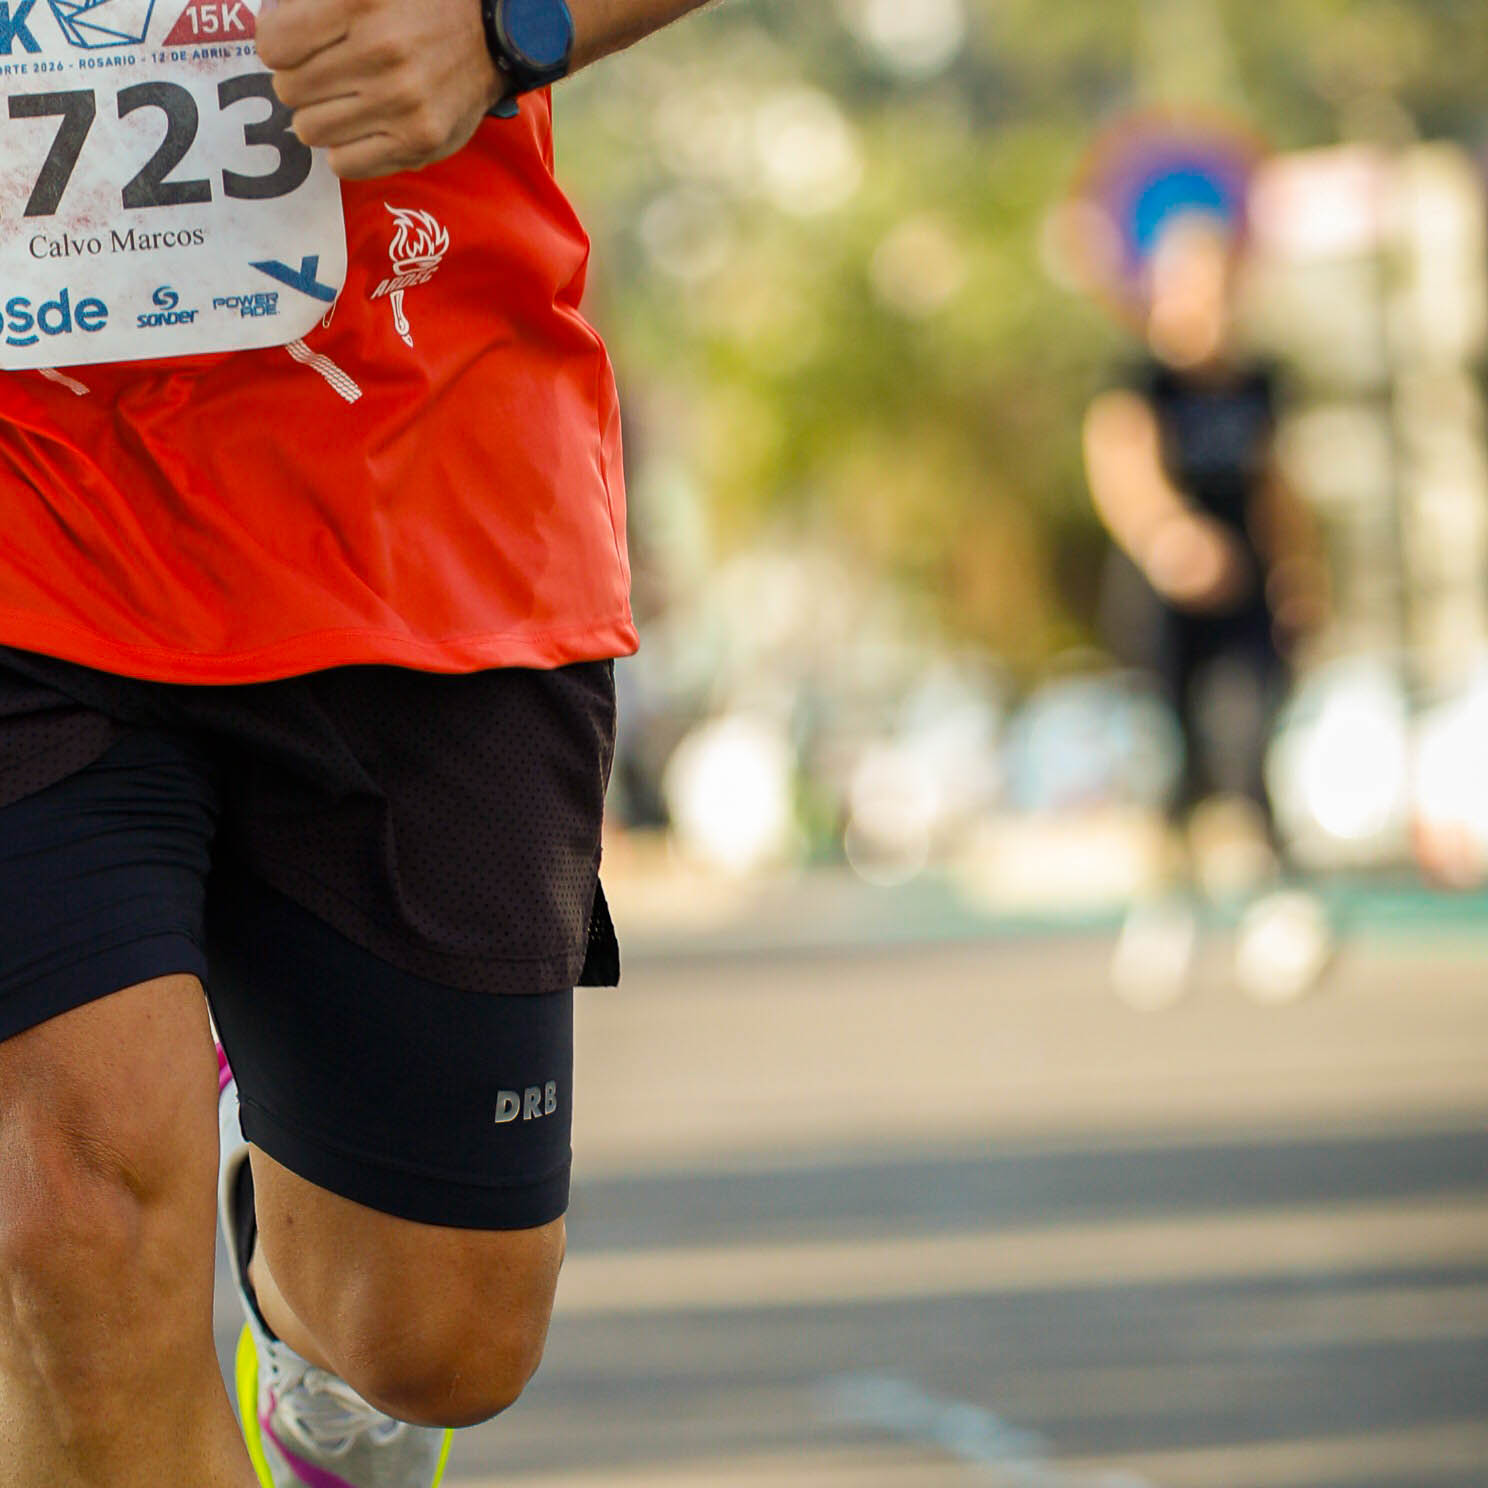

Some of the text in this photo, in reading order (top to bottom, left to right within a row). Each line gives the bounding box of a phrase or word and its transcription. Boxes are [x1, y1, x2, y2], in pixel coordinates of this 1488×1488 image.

[186, 2, 246, 35] 15K
[33, 61, 63, 73] 2026
[79, 55, 136, 69] ROSARIO
[152, 53, 165, 64] 12
[171, 50, 187, 62] DE
[193, 47, 231, 60] ABRIL
[236, 45, 257, 57] 202
[29, 228, 205, 259] Calvo Marcos
[213, 292, 279, 310] POWER
[494, 1080, 558, 1124] DRB
